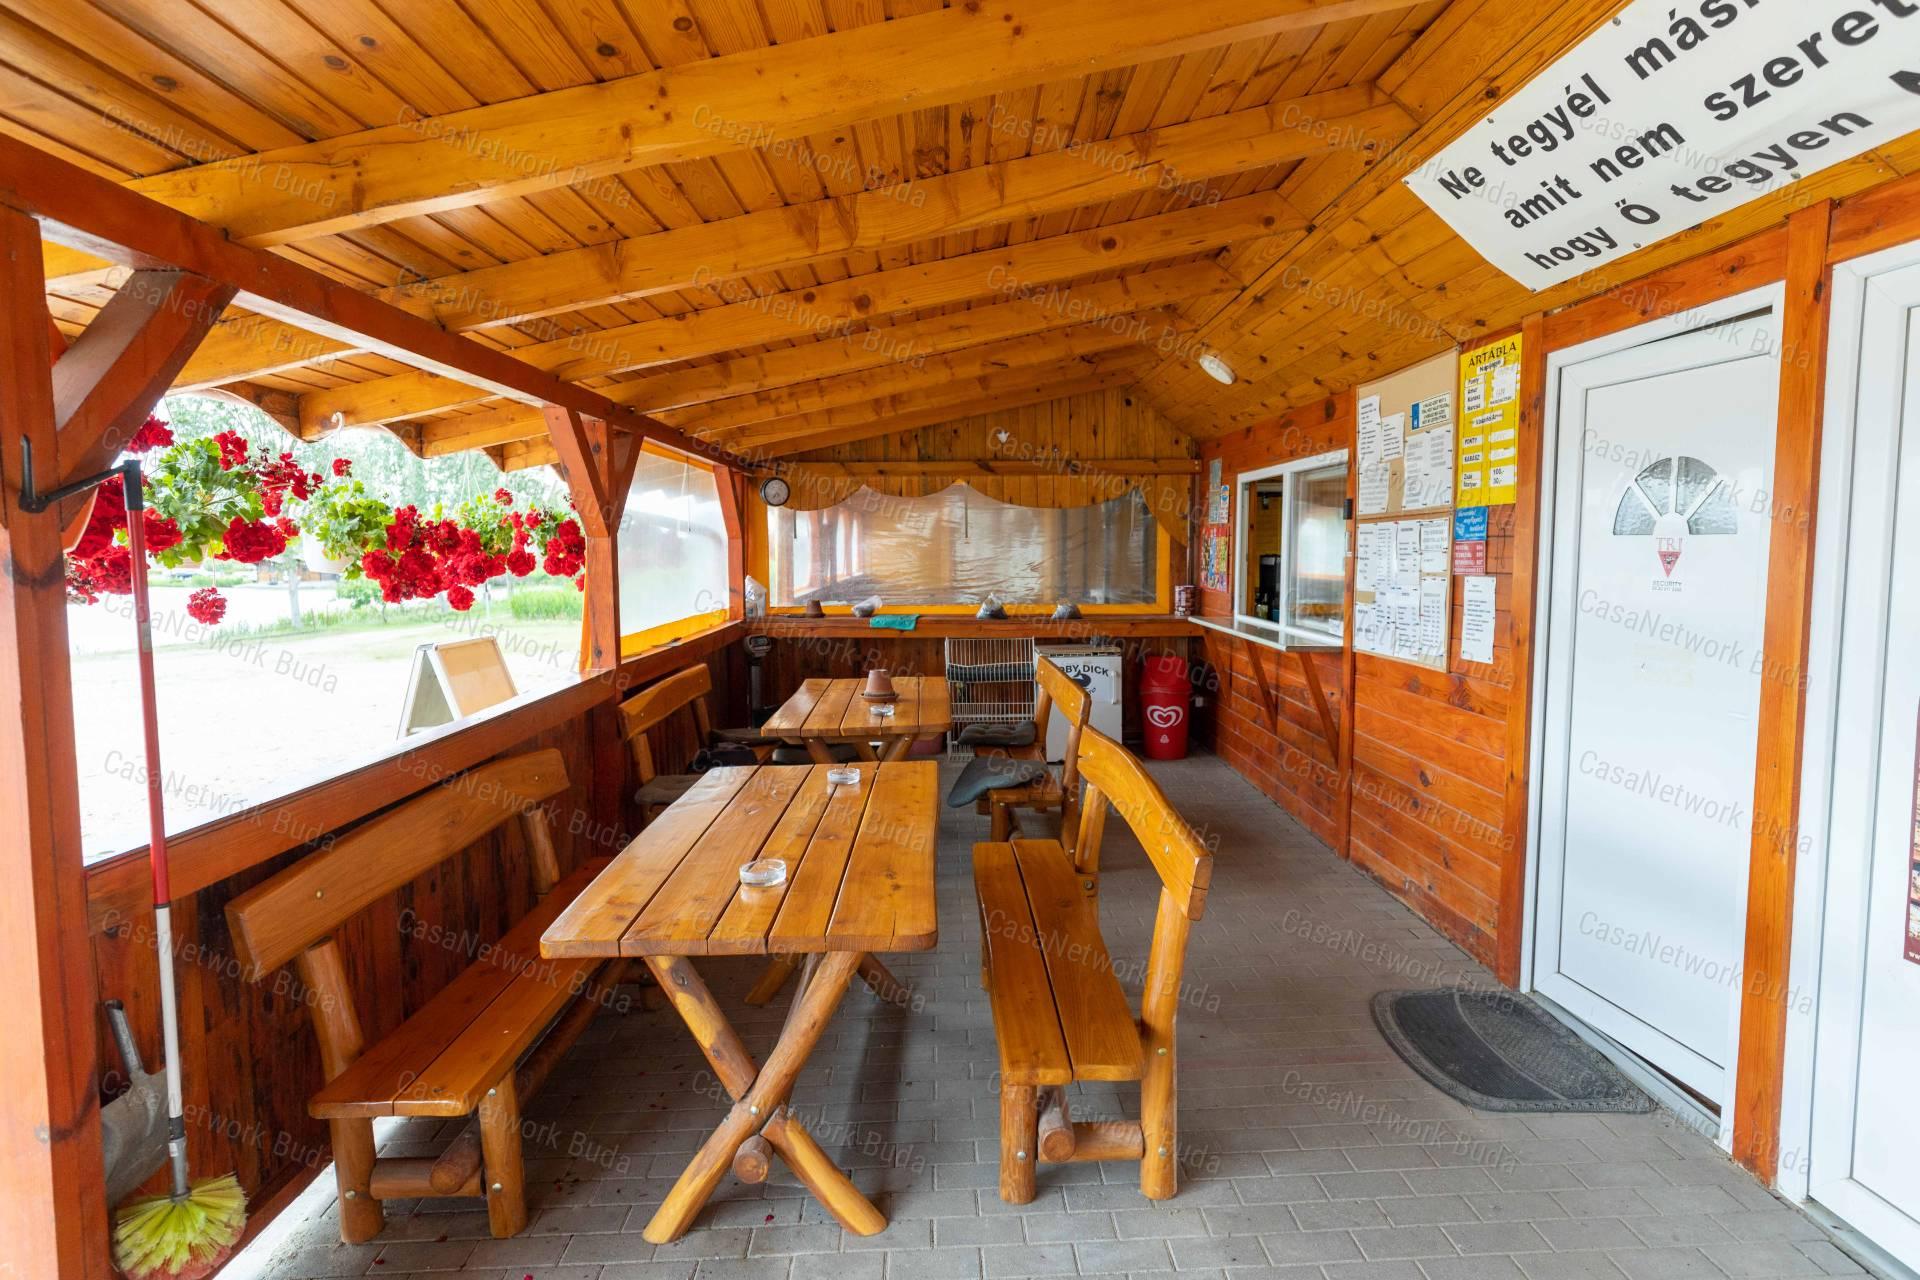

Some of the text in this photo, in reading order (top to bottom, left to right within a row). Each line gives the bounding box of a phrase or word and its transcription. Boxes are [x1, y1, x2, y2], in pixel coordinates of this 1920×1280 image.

[1438, 0, 1760, 200] Ne tegyél más
[1504, 174, 1582, 228] amit
[1589, 122, 1686, 183] nem
[1524, 112, 1874, 270] hogy Ő tegyen
[1083, 664, 1109, 677] DICK
